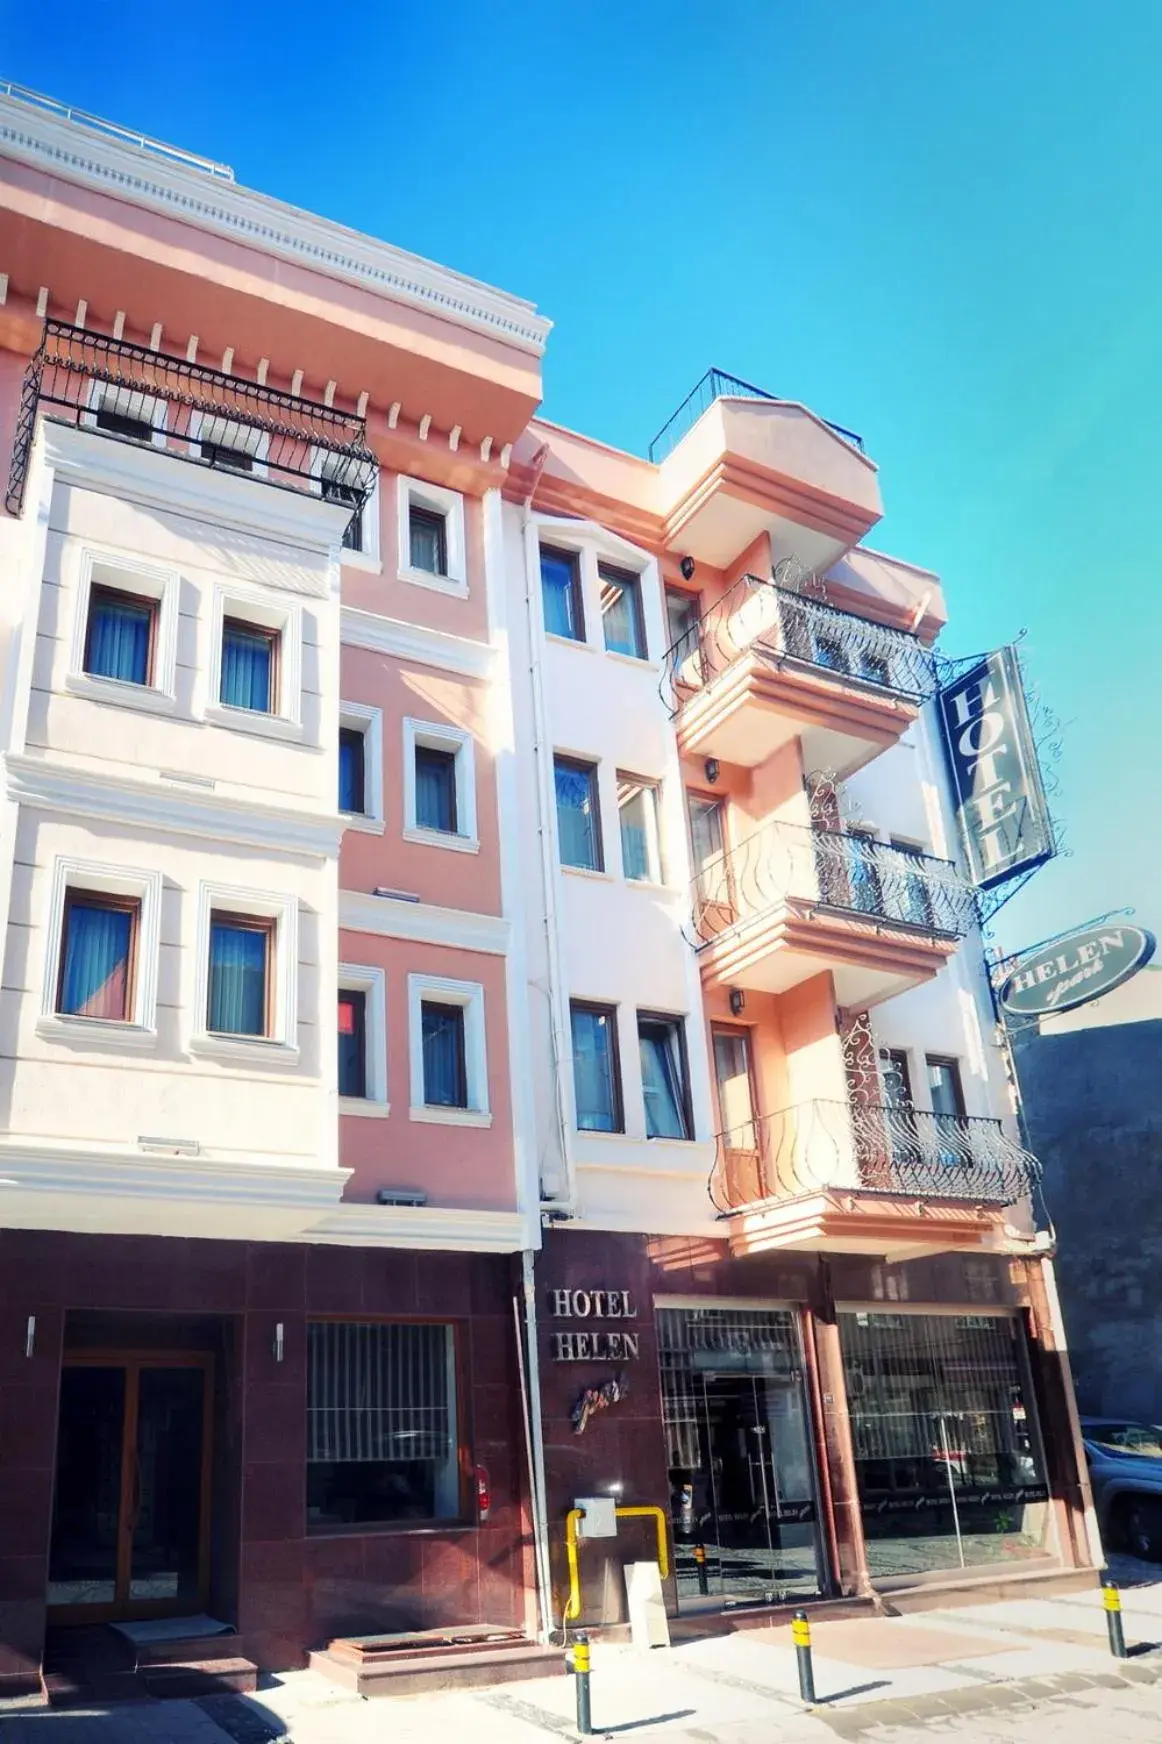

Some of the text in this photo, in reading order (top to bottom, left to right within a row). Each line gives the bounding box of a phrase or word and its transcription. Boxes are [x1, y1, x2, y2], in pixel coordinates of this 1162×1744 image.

[951, 670, 1024, 869] HOTEL
[1013, 930, 1124, 993] HELEN
[553, 1289, 637, 1317] HOTEL
[554, 1332, 640, 1361] HELEN
